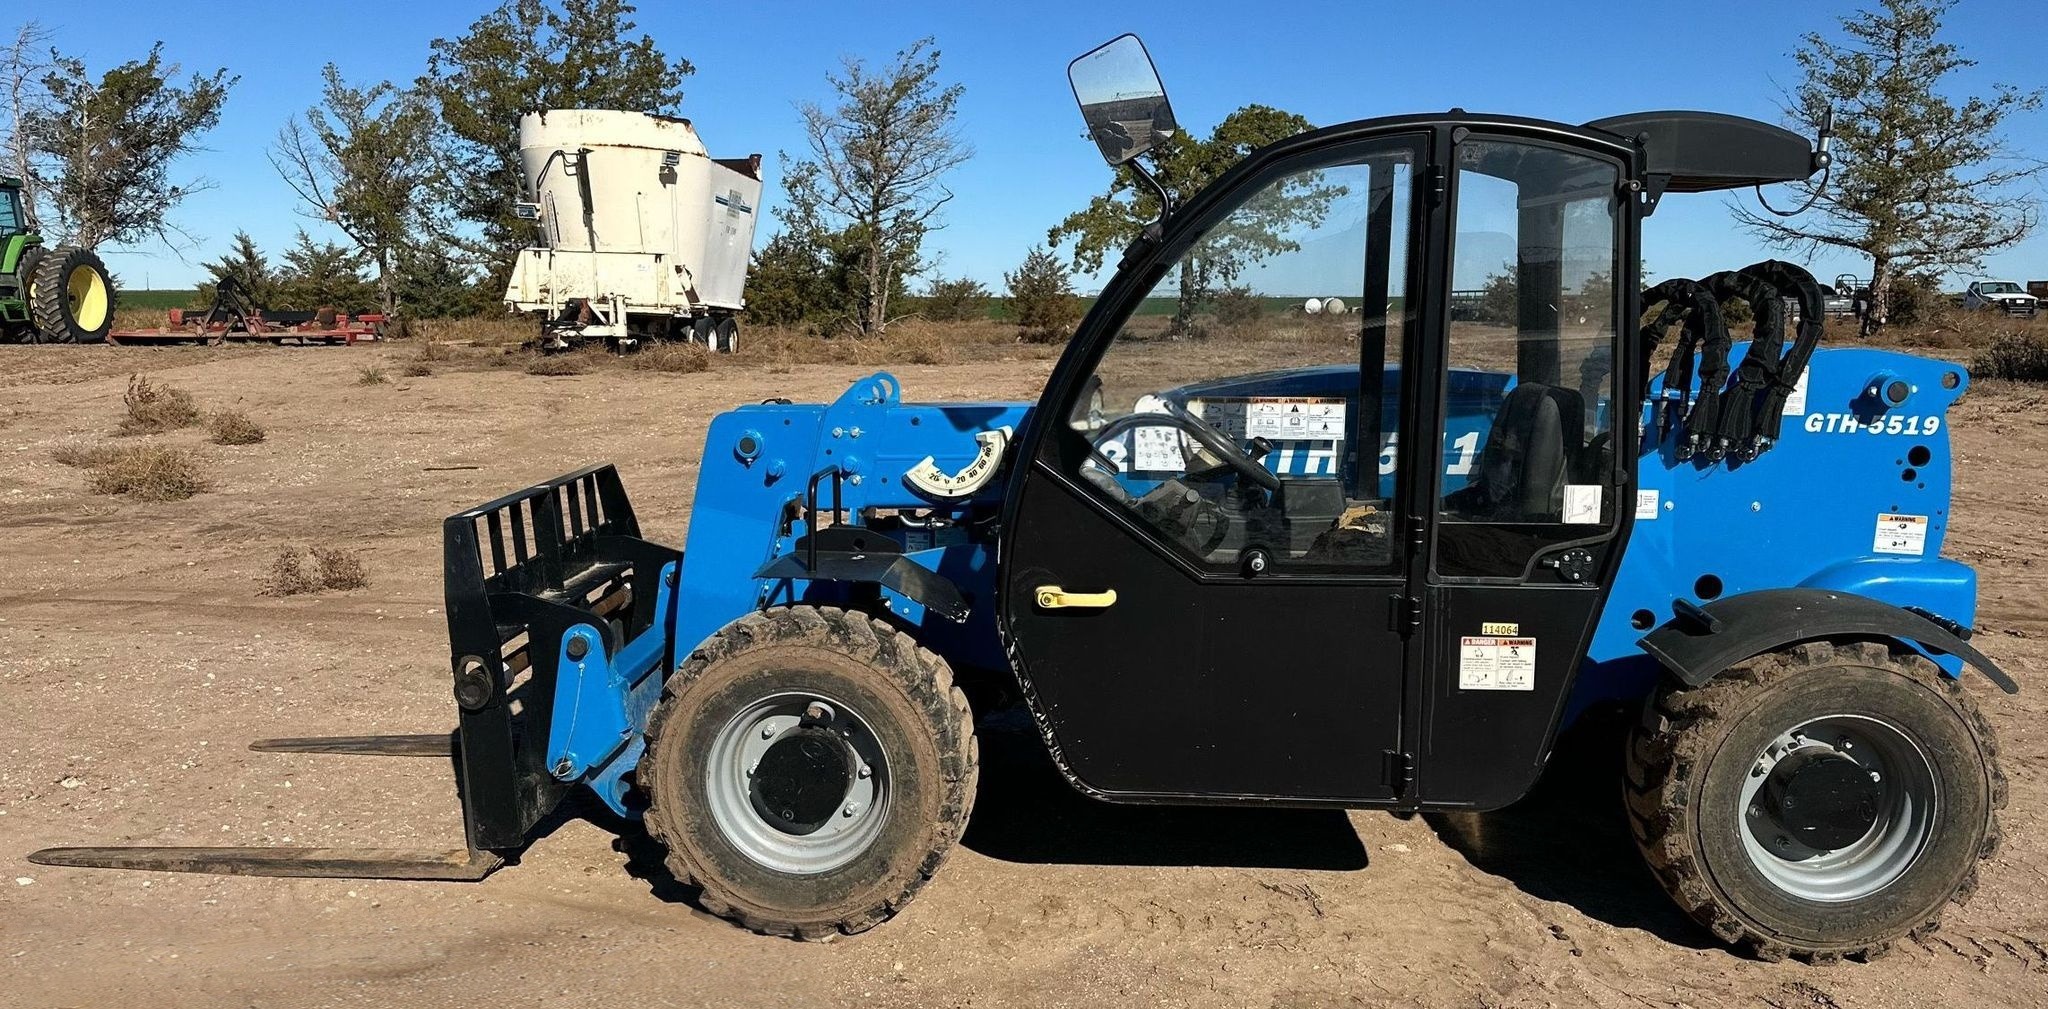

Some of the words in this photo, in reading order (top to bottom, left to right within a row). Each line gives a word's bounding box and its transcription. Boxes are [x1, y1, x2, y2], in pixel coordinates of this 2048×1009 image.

[1804, 412, 1940, 436] GTH-5519
[956, 475, 967, 484] 20
[968, 468, 979, 479] 40
[1483, 625, 1518, 635] 114064
